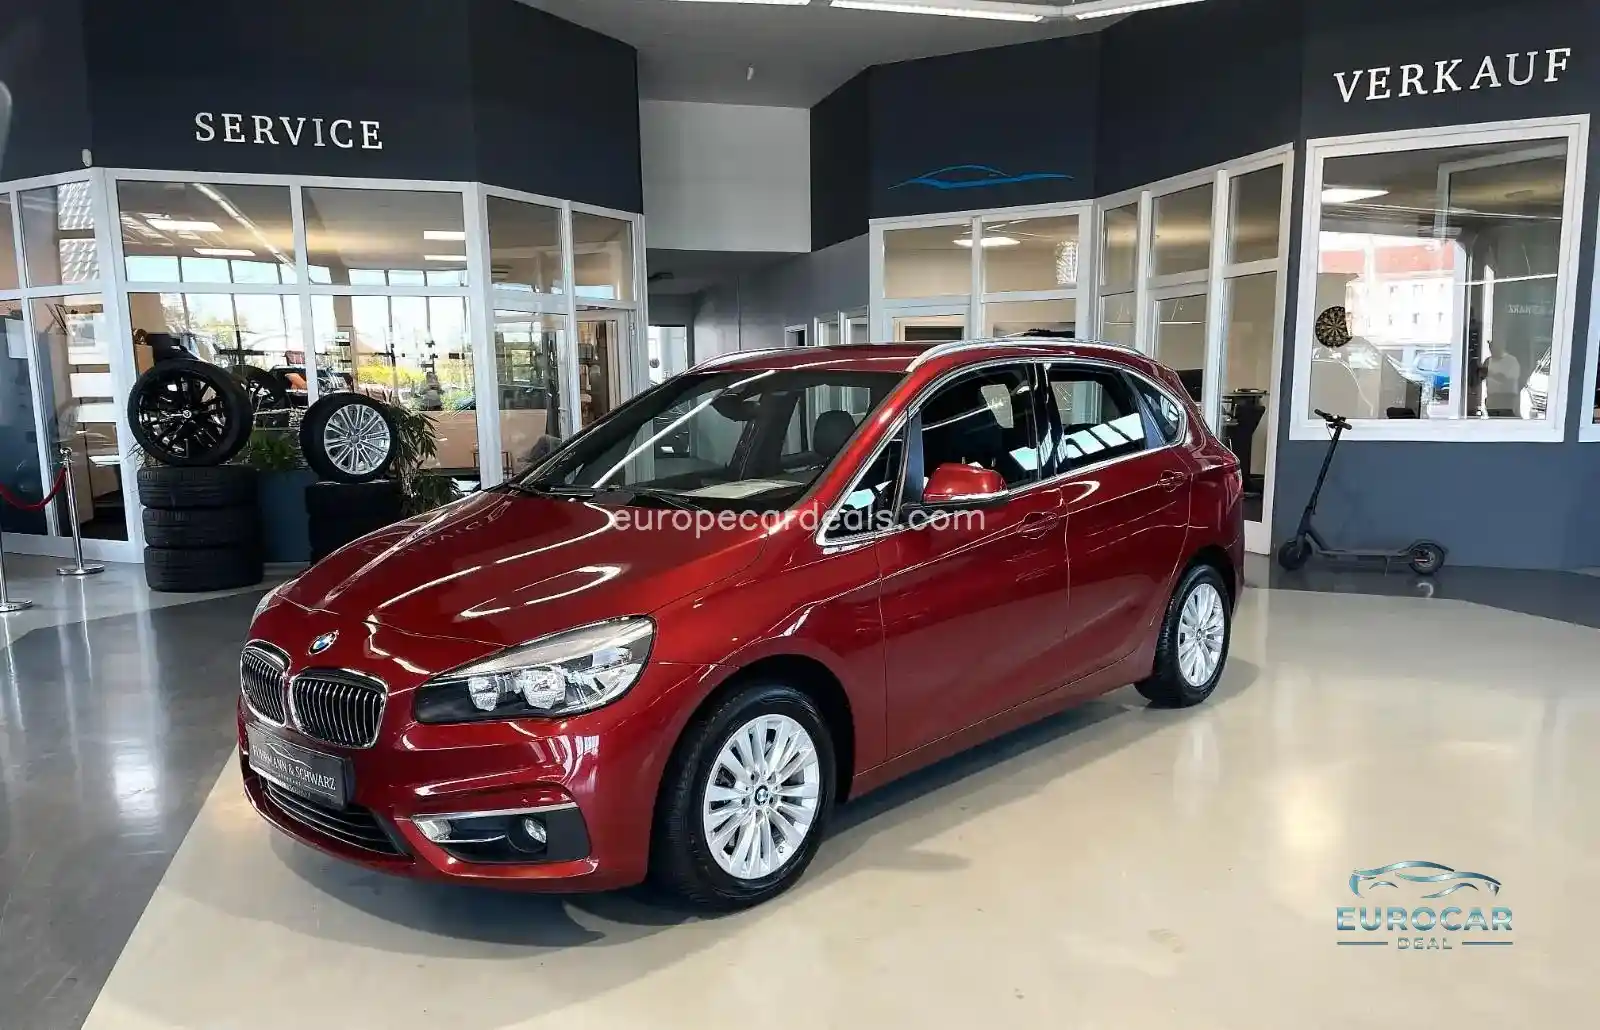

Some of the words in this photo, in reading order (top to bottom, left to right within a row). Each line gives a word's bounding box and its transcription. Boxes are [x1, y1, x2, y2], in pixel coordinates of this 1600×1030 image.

[1333, 48, 1571, 103] VERKAUF
[195, 112, 383, 150] SERVICE
[288, 763, 295, 775] &
[295, 766, 336, 790] SCHWARZ
